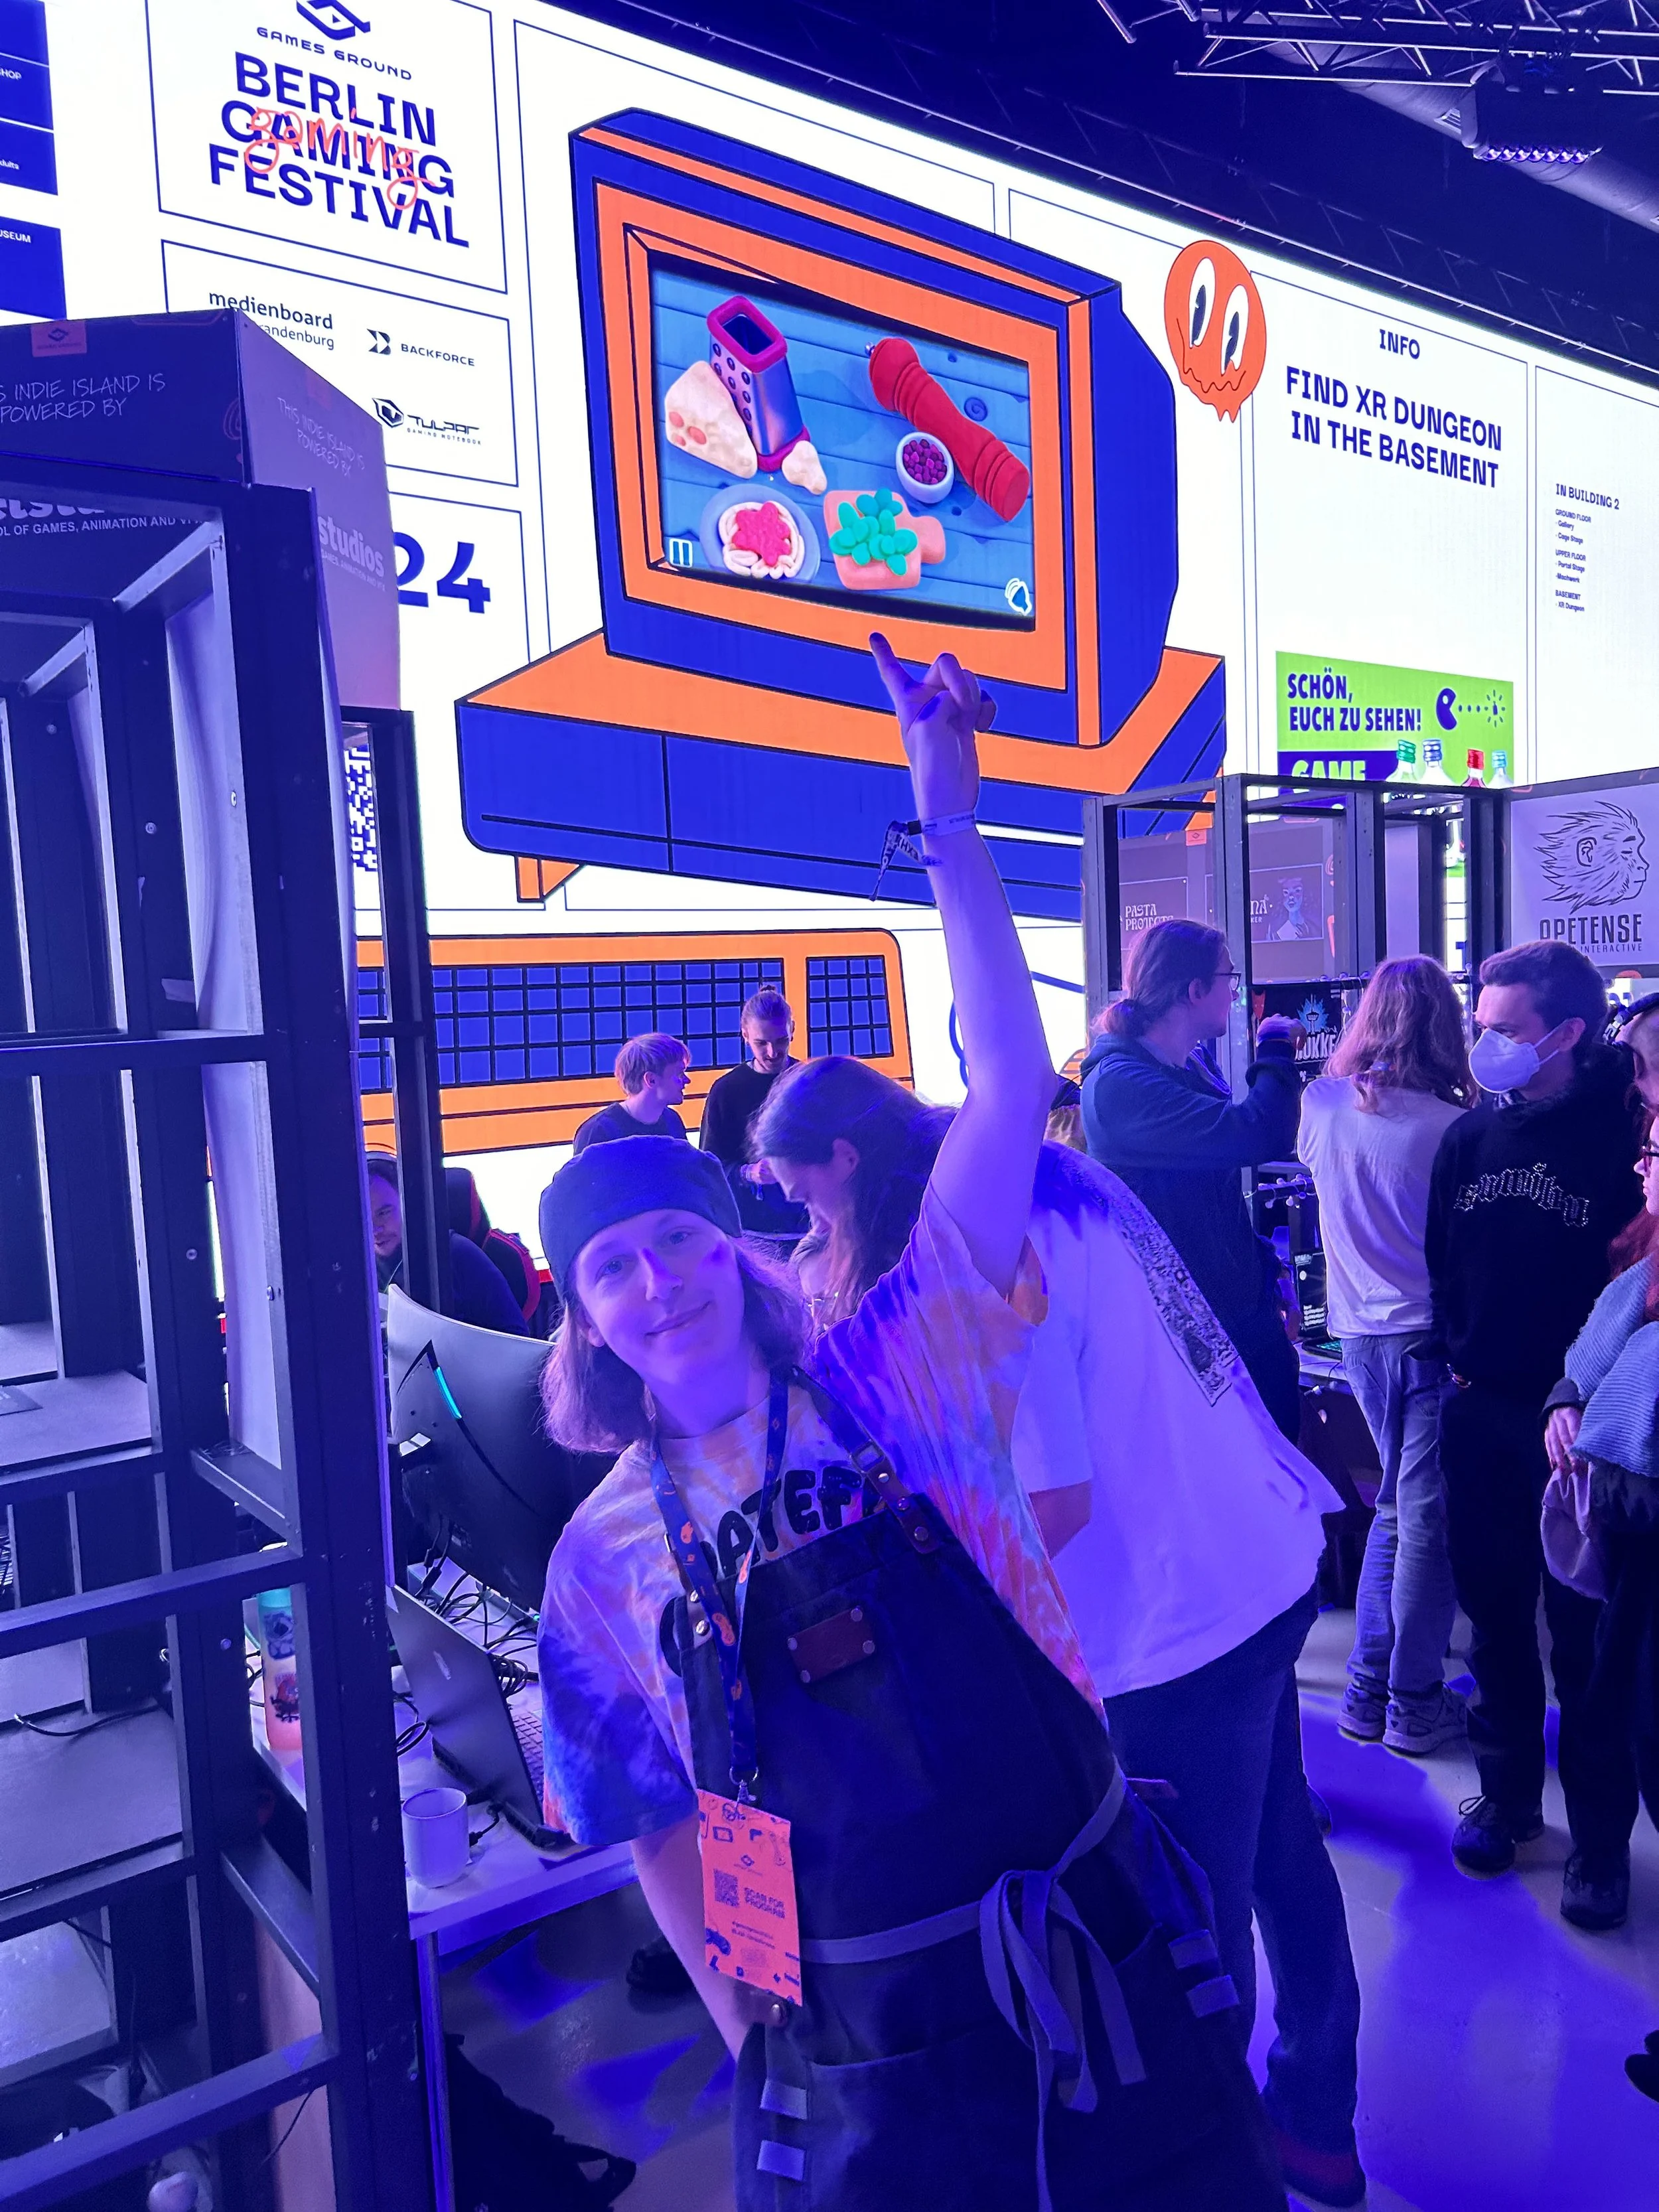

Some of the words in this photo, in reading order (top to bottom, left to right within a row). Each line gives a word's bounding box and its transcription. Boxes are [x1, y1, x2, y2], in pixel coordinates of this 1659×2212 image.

[257, 27, 326, 54] GAMES
[334, 50, 412, 80] GROUND
[0, 67, 23, 80] HOP
[235, 51, 437, 147] BERLIN
[221, 100, 455, 197] GAMING
[208, 143, 470, 248] FESTIVAL
[208, 292, 334, 330] medienboard
[401, 343, 475, 366] BACKFORCE
[1379, 329, 1421, 360] INFO
[15, 380, 65, 401] INDIE
[72, 375, 141, 397] ISLAND
[149, 373, 165, 392] IS
[0, 400, 96, 423] POWERED
[103, 397, 128, 417] BY
[1287, 365, 1348, 408] FIND
[1356, 385, 1387, 421] XR
[1394, 396, 1502, 451] DUNGEON
[277, 397, 300, 424] THIS
[302, 414, 325, 439] INDIE
[326, 431, 356, 461] ISLAND
[297, 428, 340, 469] POWERED
[1291, 410, 1321, 445] IN
[1327, 419, 1372, 458] THE
[1380, 433, 1499, 488] BASEMENT
[1555, 483, 1567, 496] IN
[1569, 486, 1612, 508] BUILDING
[1614, 498, 1620, 510] 2
[13, 524, 30, 536] OF
[33, 521, 79, 534] GAMES,
[81, 517, 147, 531] ANIMATION
[150, 516, 176, 526] AND
[1555, 508, 1575, 520] GROUND
[1576, 514, 1591, 523] FLOOR
[318, 516, 385, 578] studios
[1555, 549, 1570, 558] UPPER
[1571, 552, 1586, 561] FLOOR
[1555, 589, 1581, 600] BASEMENT
[1287, 666, 1353, 703] SCHÖN,
[1289, 706, 1334, 731] EUCH
[1340, 707, 1360, 732] ZU
[1364, 707, 1421, 732] SEHEN!
[1125, 903, 1157, 918] PASTA
[1580, 943, 1643, 954] INTERACTIVE
